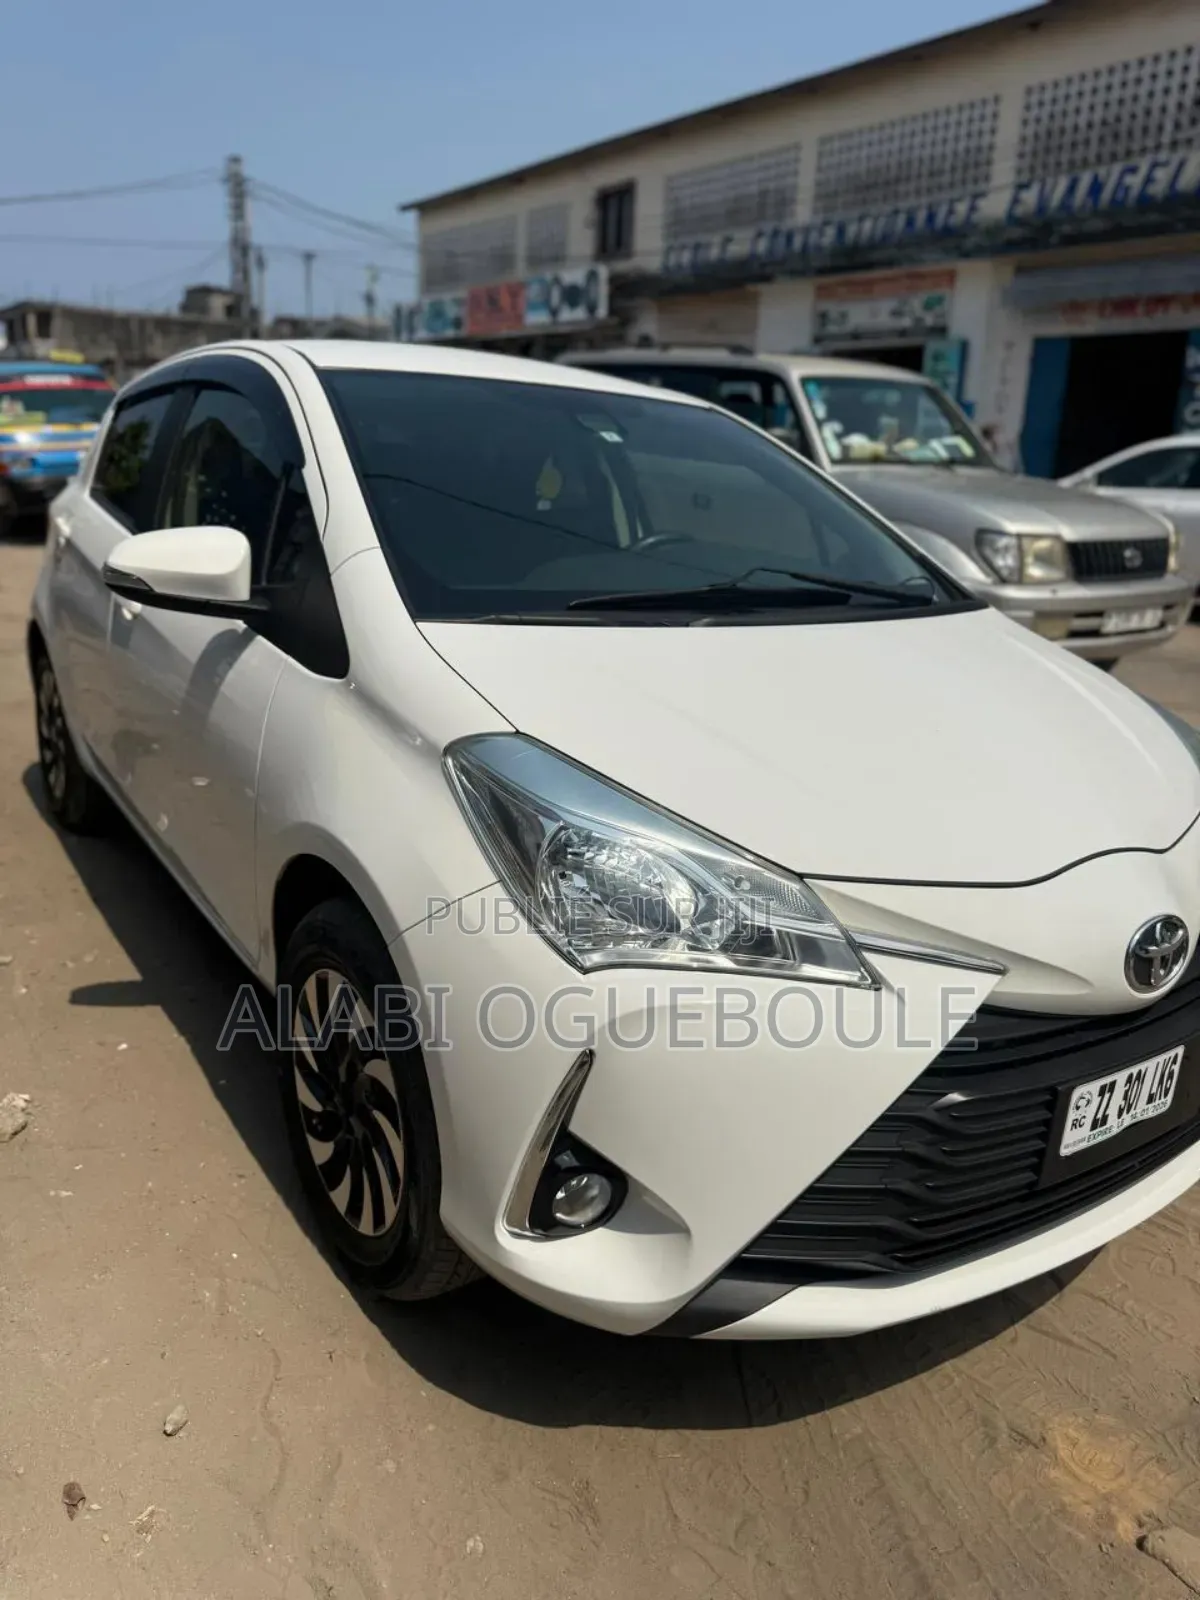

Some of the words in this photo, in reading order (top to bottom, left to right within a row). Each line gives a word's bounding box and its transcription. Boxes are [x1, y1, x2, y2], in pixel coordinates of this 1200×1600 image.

[1005, 156, 1200, 226] EVANGEL
[1117, 1067, 1148, 1120] 301
[1145, 1051, 1179, 1105] LK6
[1070, 1115, 1087, 1131] RC
